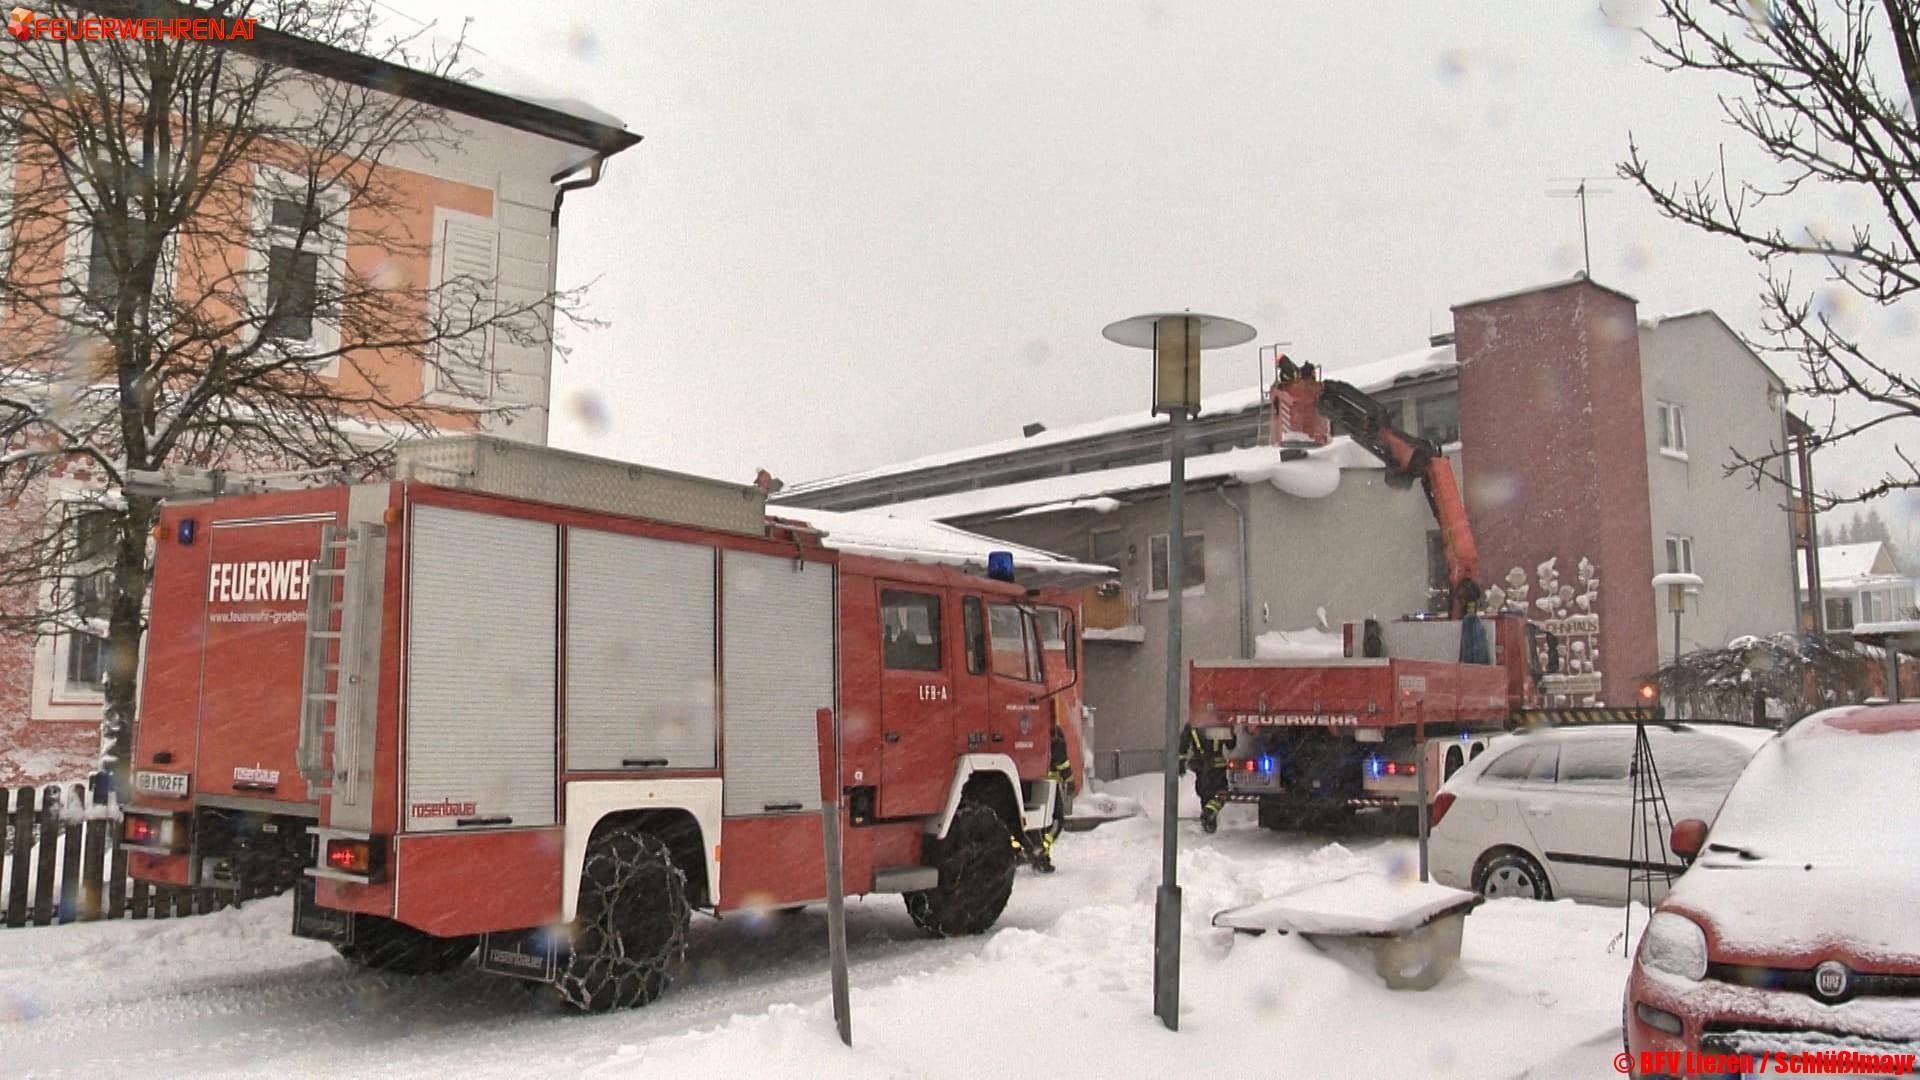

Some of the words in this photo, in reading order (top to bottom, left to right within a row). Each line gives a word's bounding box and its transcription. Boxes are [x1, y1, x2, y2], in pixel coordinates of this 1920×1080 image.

[209, 559, 311, 602] FEUERWEH
[919, 685, 948, 701] LFB-A
[1236, 714, 1358, 726] FEUERWEHR
[412, 797, 477, 818] rosenbauer
